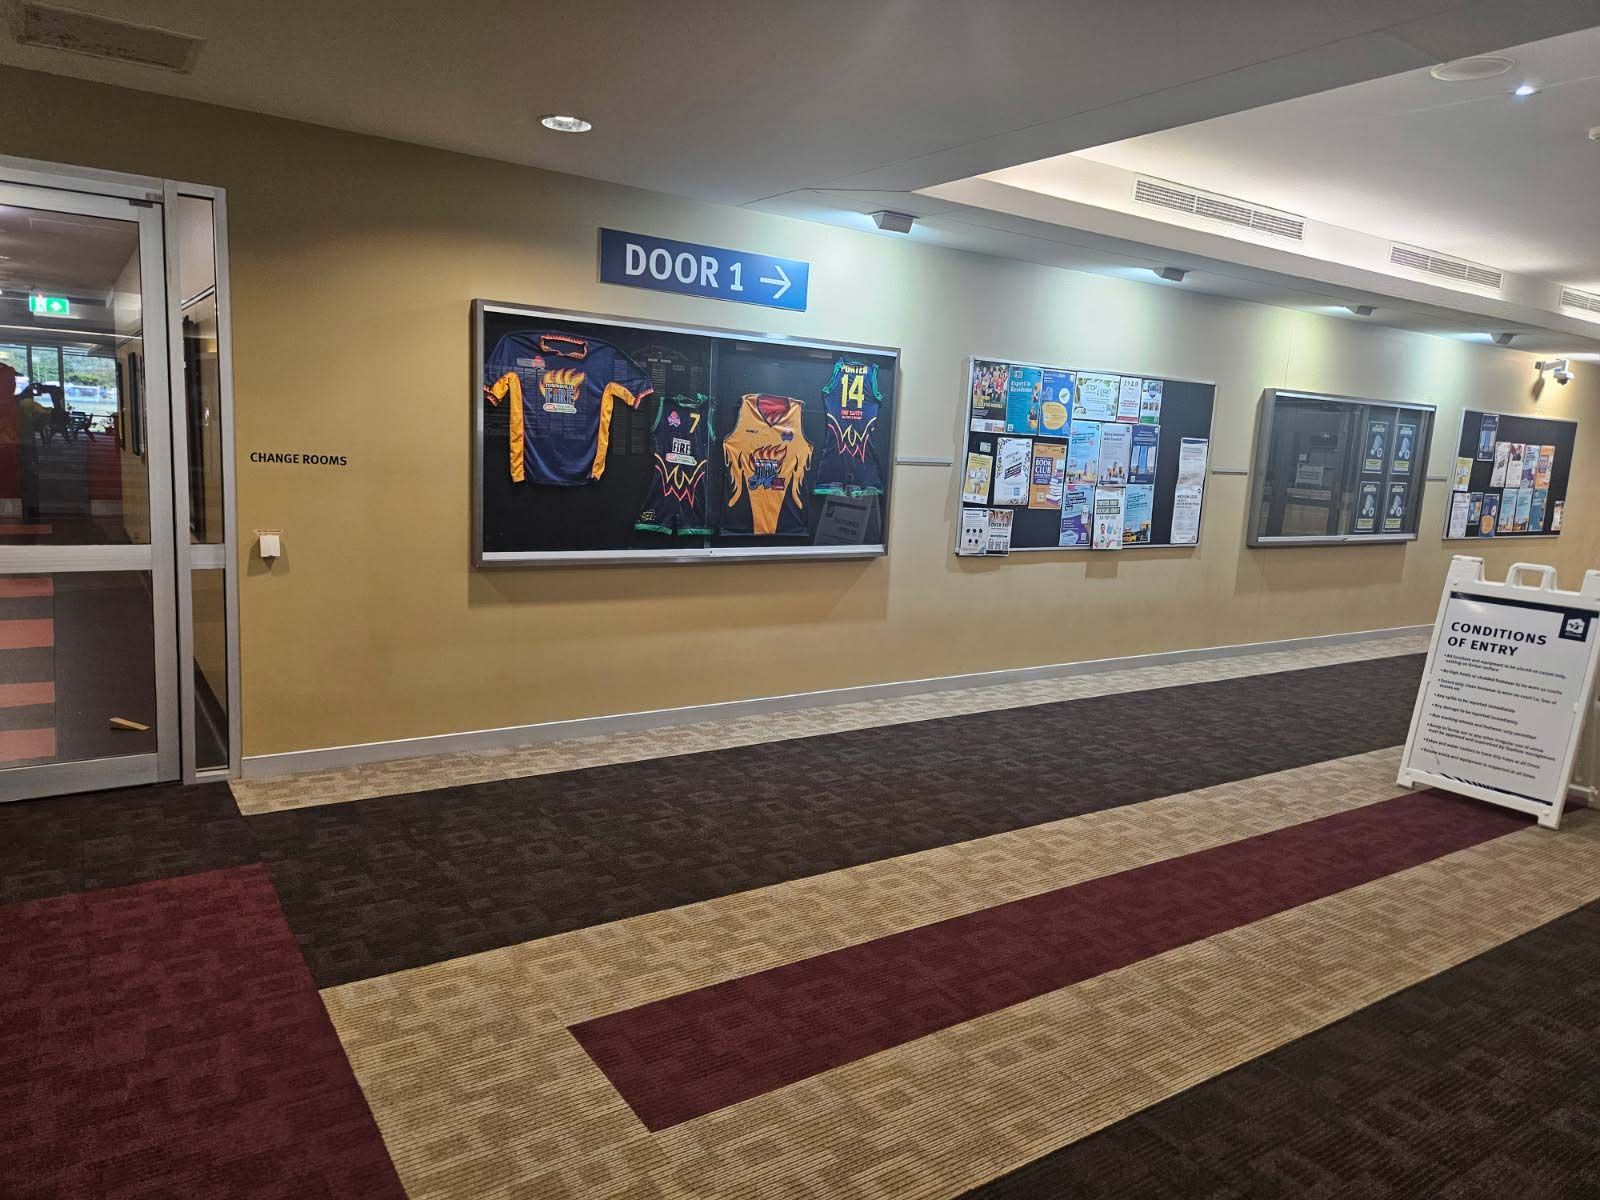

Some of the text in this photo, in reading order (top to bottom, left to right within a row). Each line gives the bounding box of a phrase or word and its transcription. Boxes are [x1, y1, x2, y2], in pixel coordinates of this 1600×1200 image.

[625, 243, 744, 292] DOOR 1
[546, 388, 576, 406] FIRE
[841, 374, 865, 408] 14
[688, 412, 701, 434] 7
[673, 441, 691, 454] FIRE
[250, 452, 348, 466] CHANGE ROOMS
[1451, 622, 1548, 646] CONDITIONS
[1447, 636, 1519, 656] OF ENTRY
